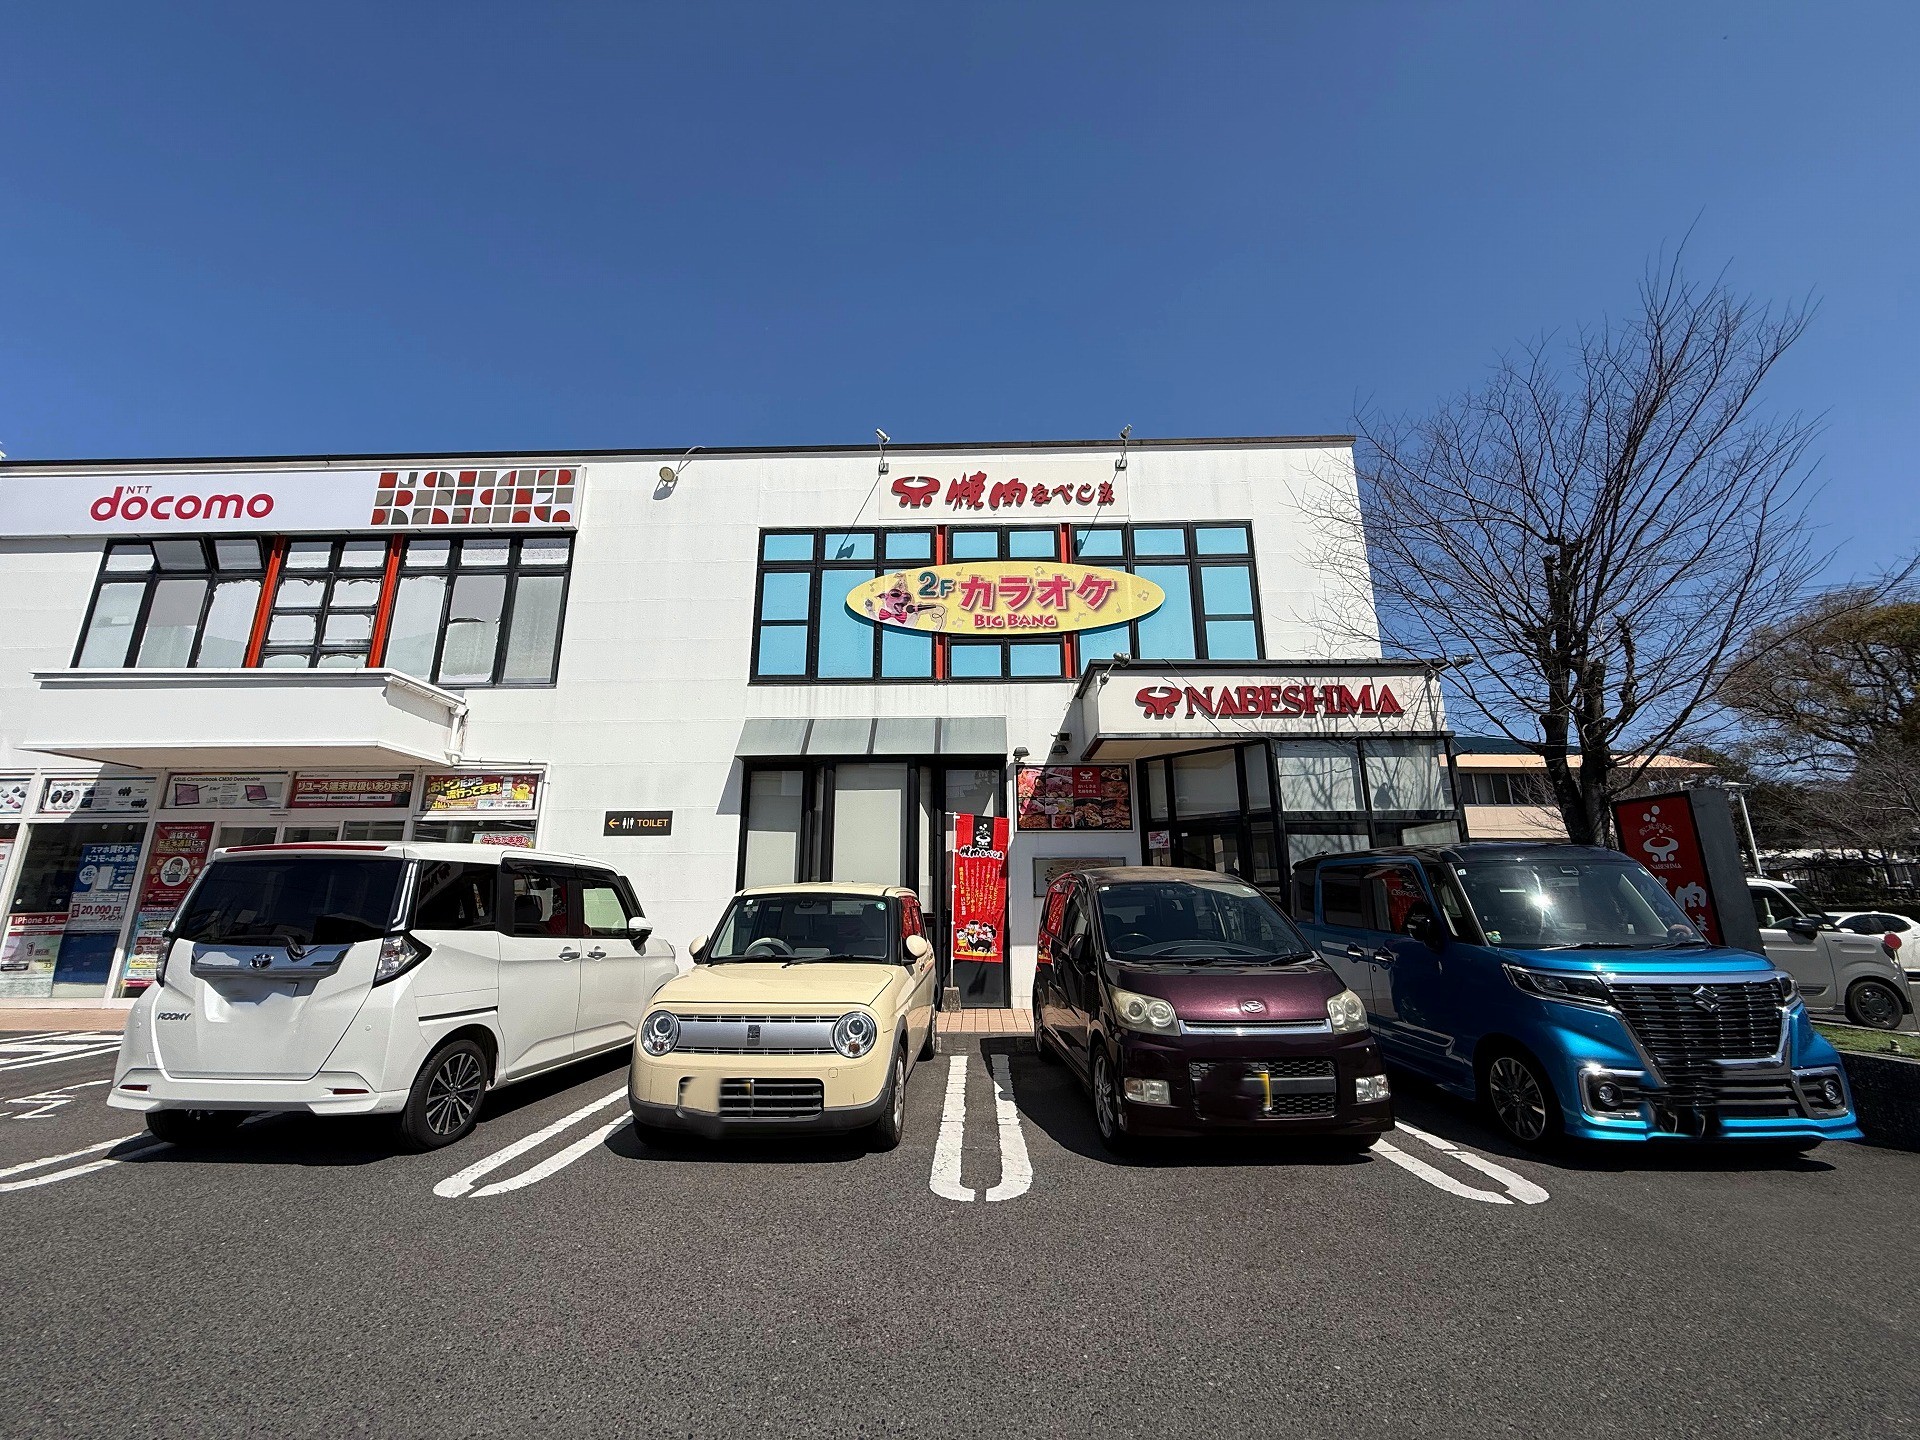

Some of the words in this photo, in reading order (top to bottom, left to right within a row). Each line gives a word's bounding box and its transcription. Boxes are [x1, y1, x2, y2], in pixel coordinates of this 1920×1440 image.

[126, 485, 153, 494] NTT
[90, 486, 275, 521] docomo
[917, 571, 955, 598] 2F
[957, 572, 1117, 612] カラオケ
[974, 613, 1004, 629] BIG
[1007, 613, 1058, 629] BANG
[1183, 684, 1406, 719] NABESHIMA
[636, 818, 669, 828] TOILET
[14, 916, 43, 925] iPhone
[44, 915, 56, 924] 16
[157, 1012, 192, 1021] ROOMY
